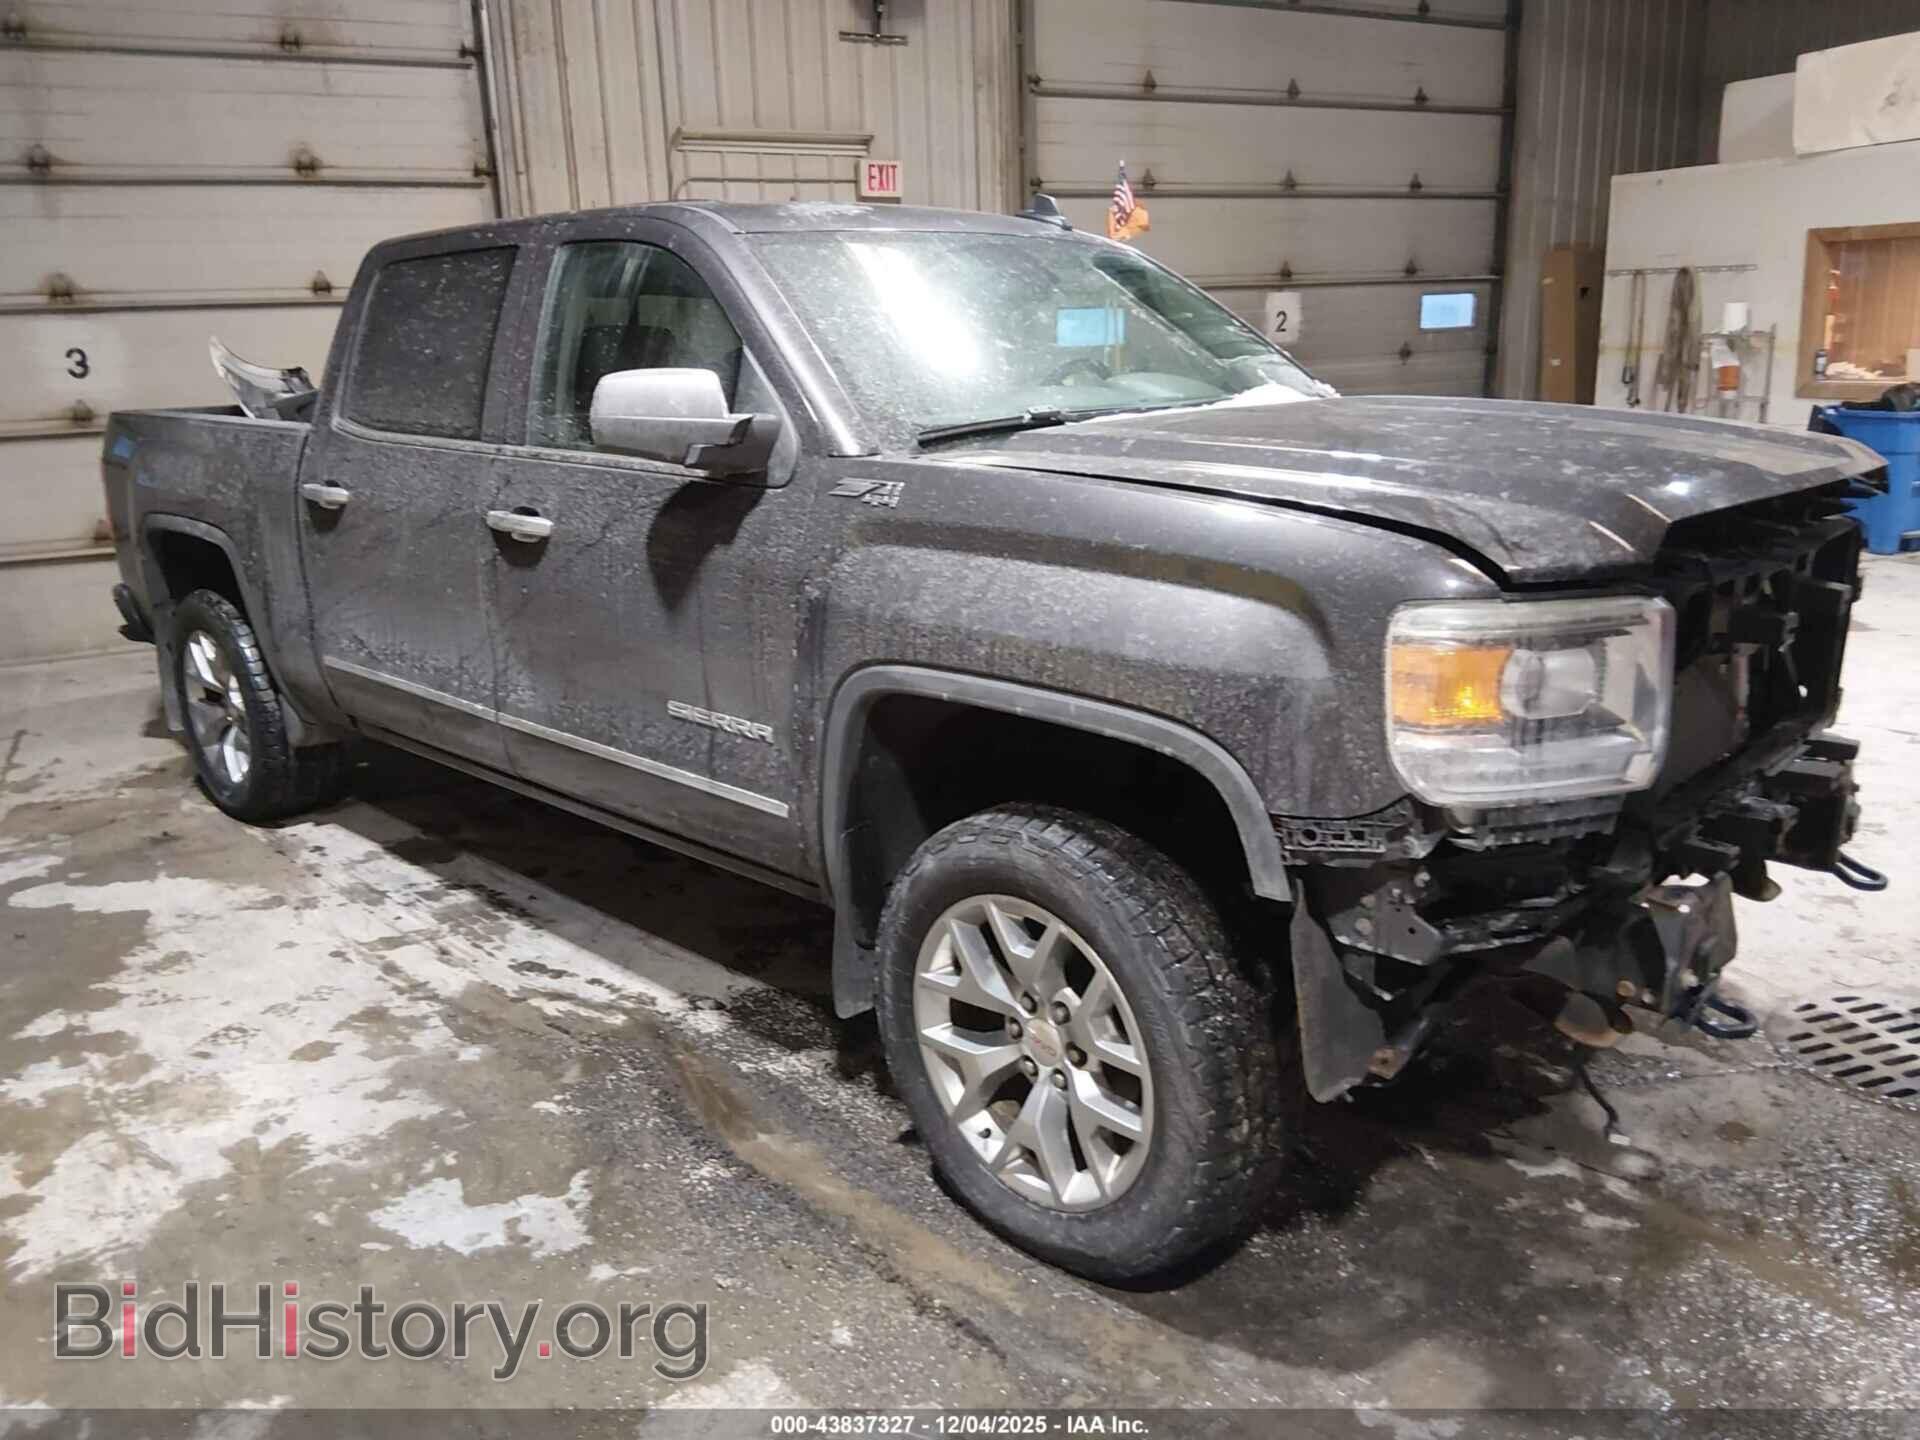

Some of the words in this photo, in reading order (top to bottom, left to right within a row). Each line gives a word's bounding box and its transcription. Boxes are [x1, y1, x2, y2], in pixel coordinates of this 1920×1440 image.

[868, 164, 897, 192] EXIT
[1275, 310, 1287, 332] 2
[66, 348, 89, 379] 3
[667, 700, 774, 744] SIERRA
